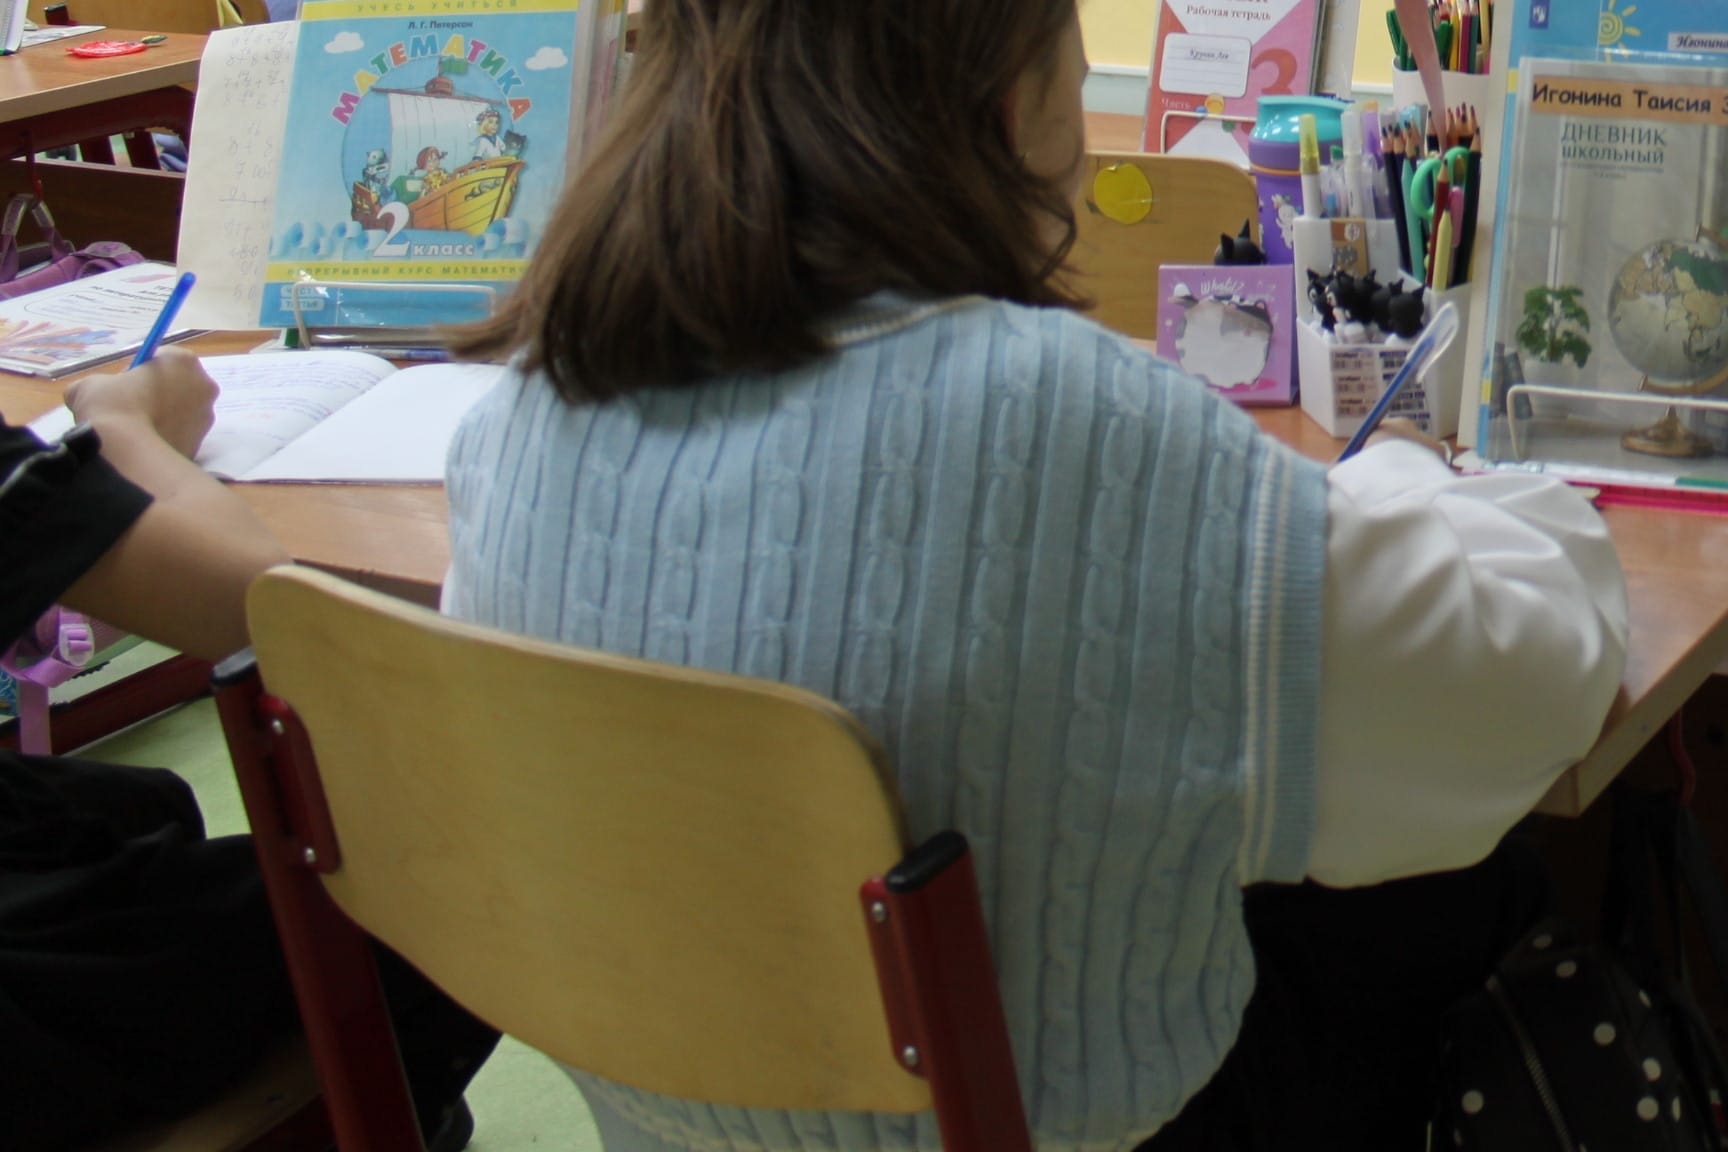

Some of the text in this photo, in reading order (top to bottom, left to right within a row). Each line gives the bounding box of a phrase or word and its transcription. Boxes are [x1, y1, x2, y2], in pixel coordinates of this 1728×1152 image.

[429, 20, 474, 30] Петерсон
[1186, 4, 1271, 22] Рабочая тетрадь
[331, 32, 533, 127] МАТЕМАТИКА
[1531, 83, 1622, 108] Игонина
[1633, 89, 1711, 114] Таисия
[1561, 122, 1668, 146] ДНЕВНИК
[373, 201, 475, 257] 2 класс
[398, 265, 433, 275] КУРС
